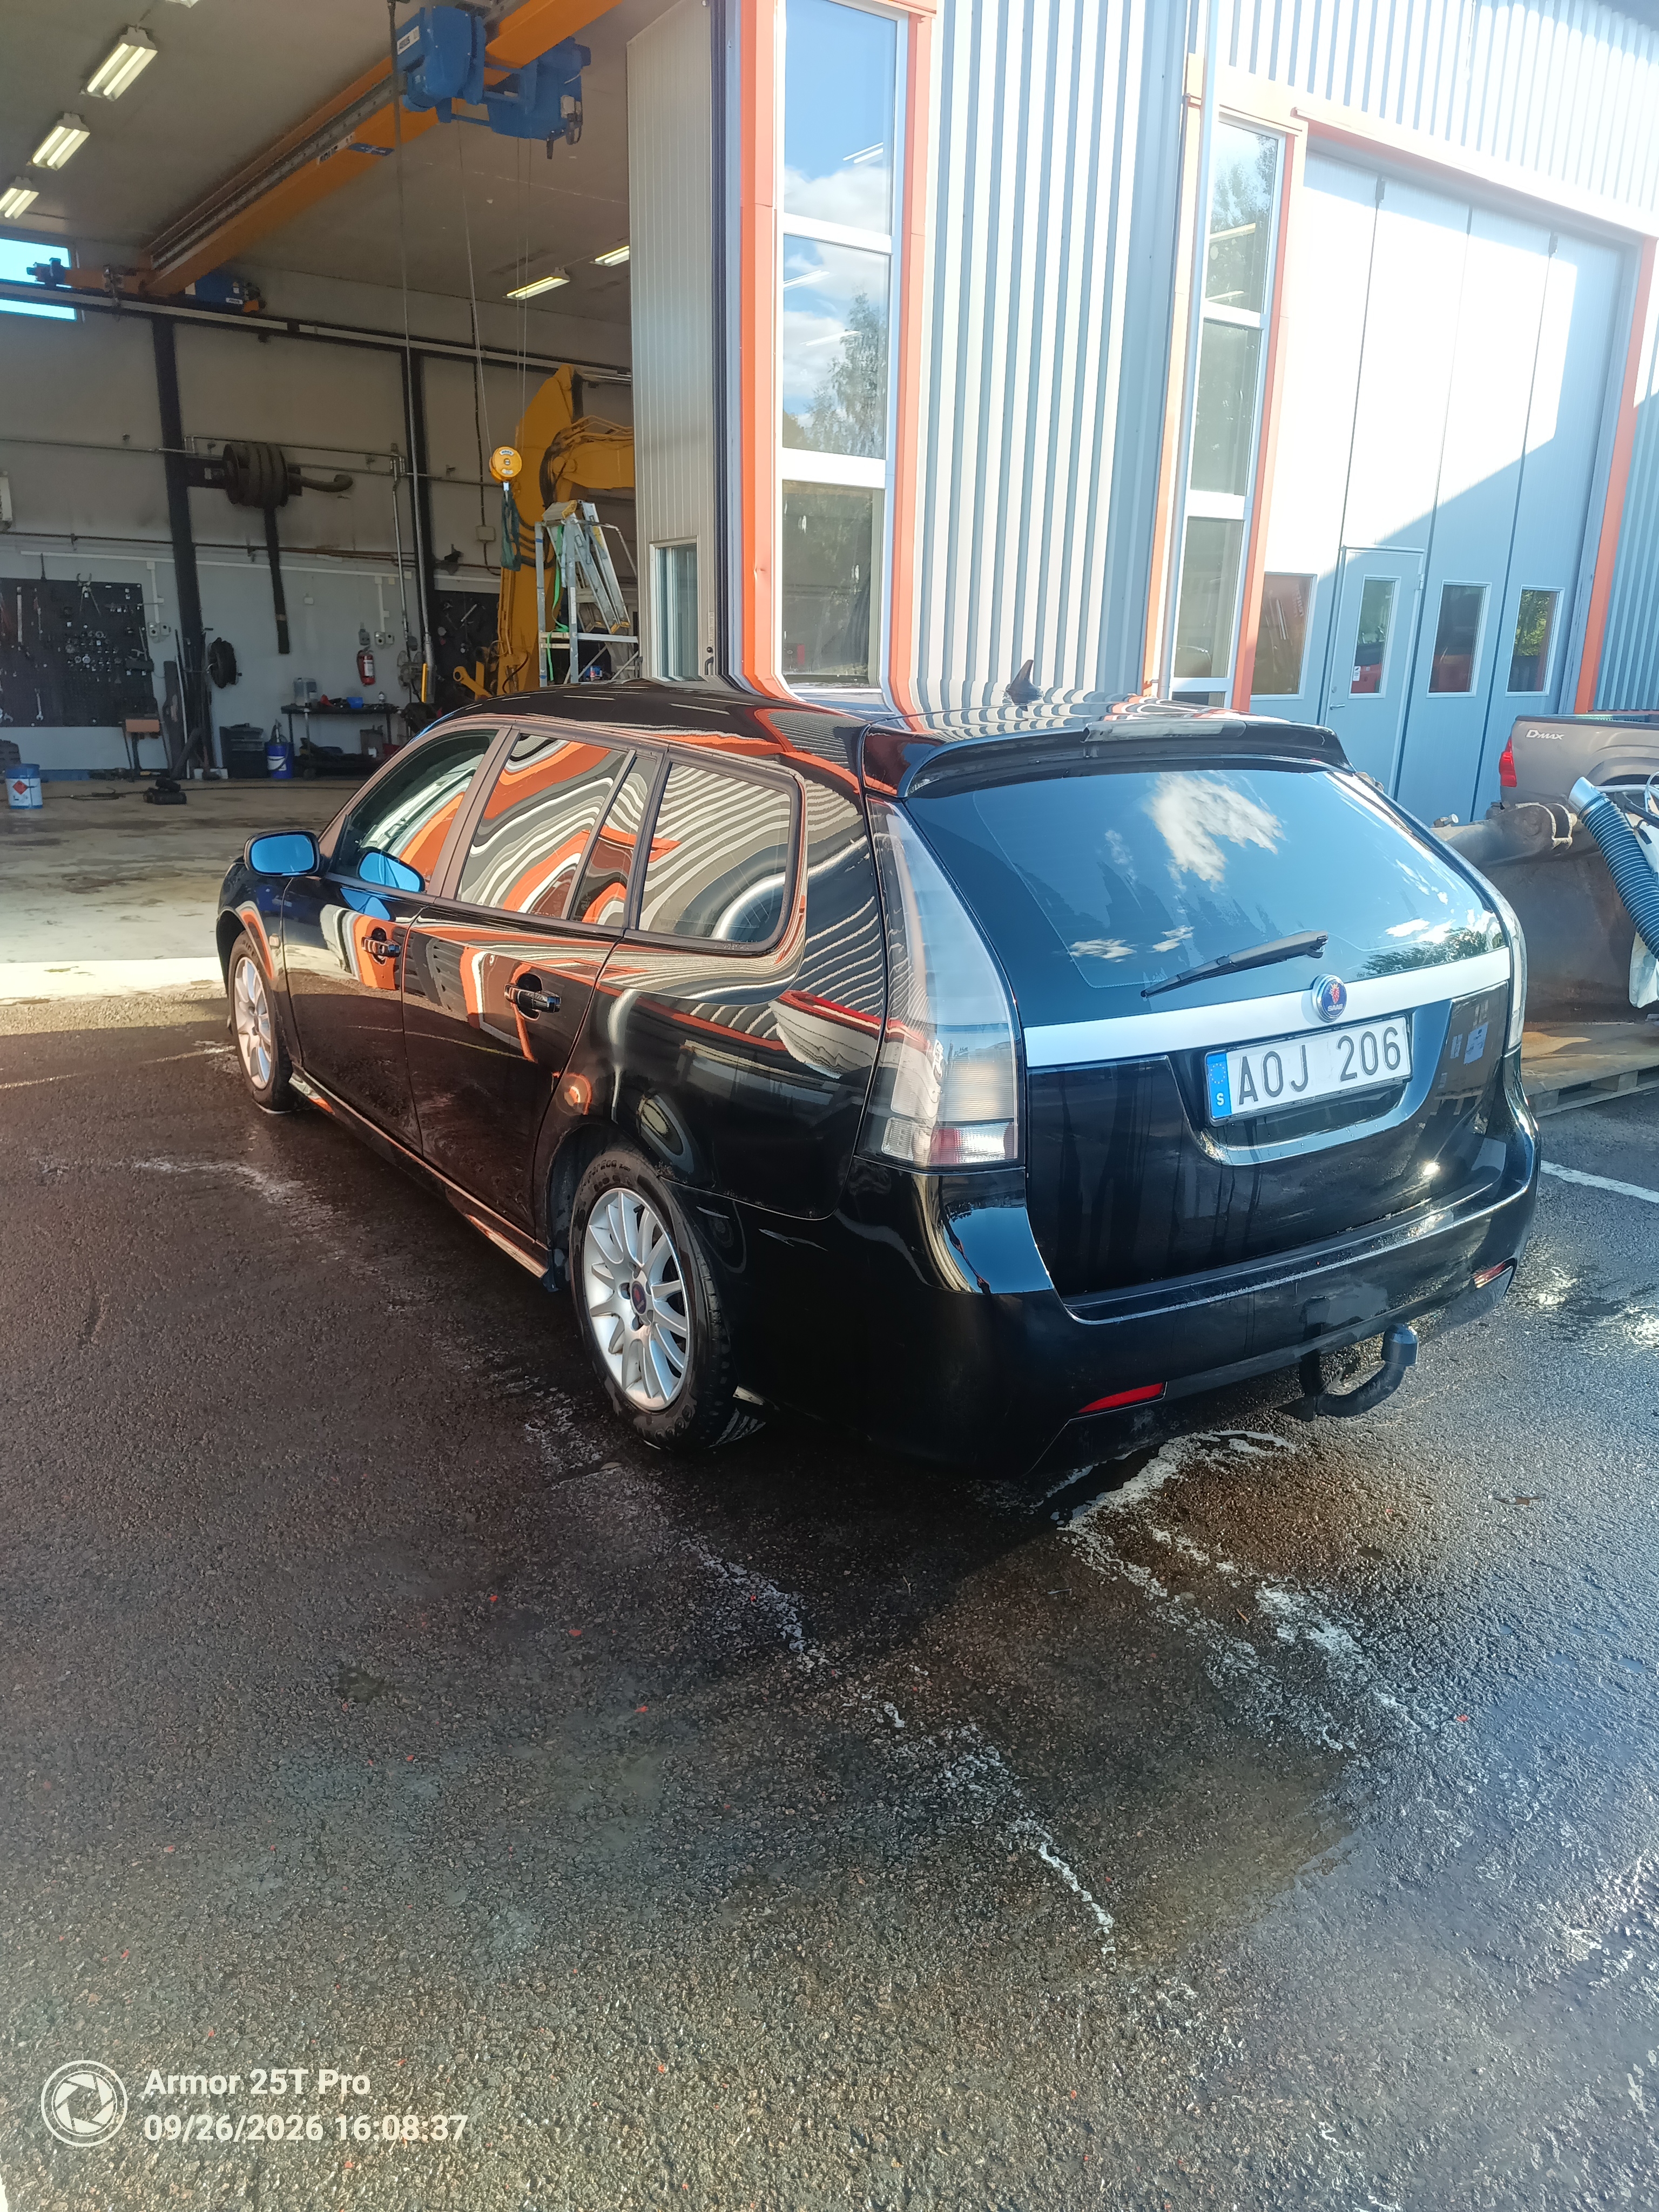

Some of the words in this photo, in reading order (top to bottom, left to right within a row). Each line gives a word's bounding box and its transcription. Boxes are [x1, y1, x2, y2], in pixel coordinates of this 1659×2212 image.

[1327, 1003, 1343, 1011] SAAB
[1238, 1044, 1309, 1105] AOJ
[1337, 1026, 1401, 1082] 206
[1217, 1092, 1224, 1106] S
